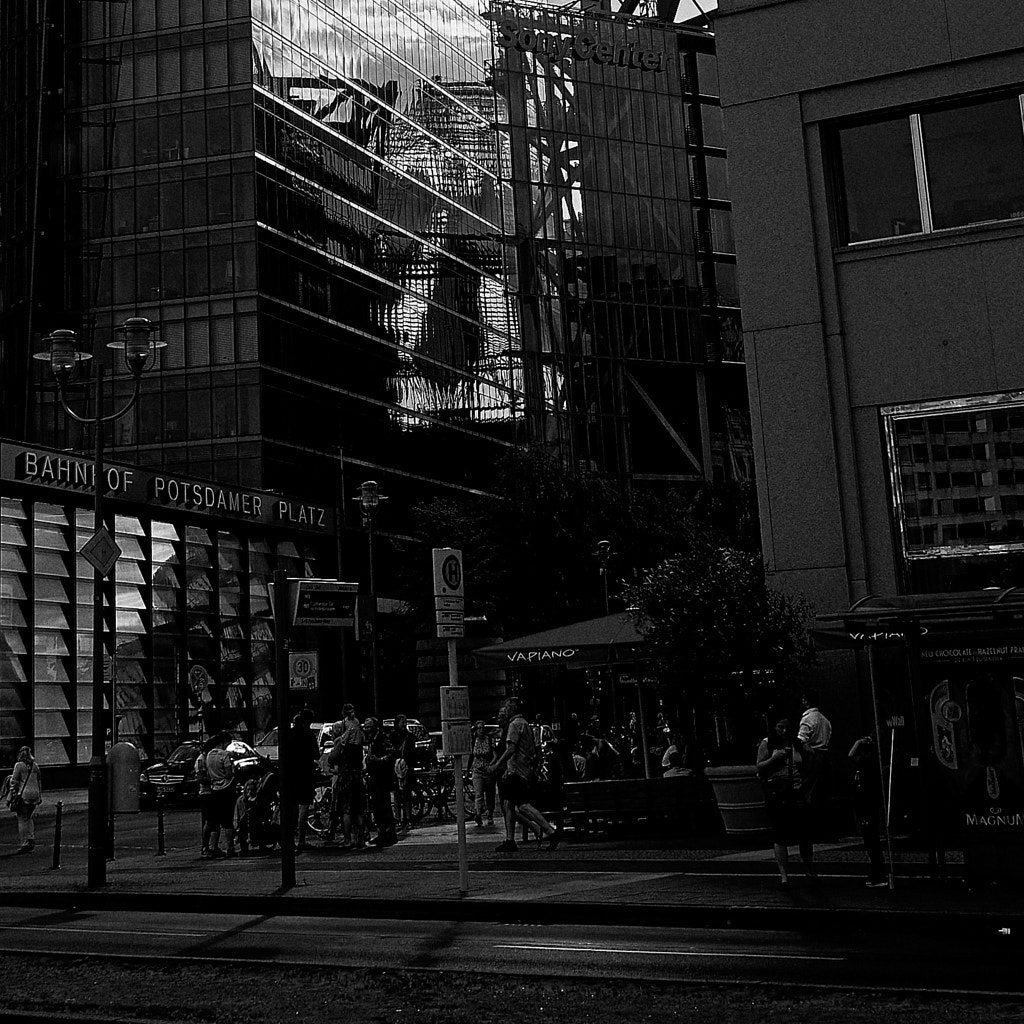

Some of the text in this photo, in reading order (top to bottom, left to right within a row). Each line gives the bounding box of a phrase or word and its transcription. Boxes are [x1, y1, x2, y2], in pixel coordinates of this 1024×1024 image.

[498, 19, 673, 71] Sony Center
[155, 477, 262, 516] POTSDAMER
[279, 501, 326, 526] PLATZ
[507, 649, 576, 662] VAPIANO
[297, 661, 309, 674] 30
[966, 814, 1024, 827] MAGNUM
